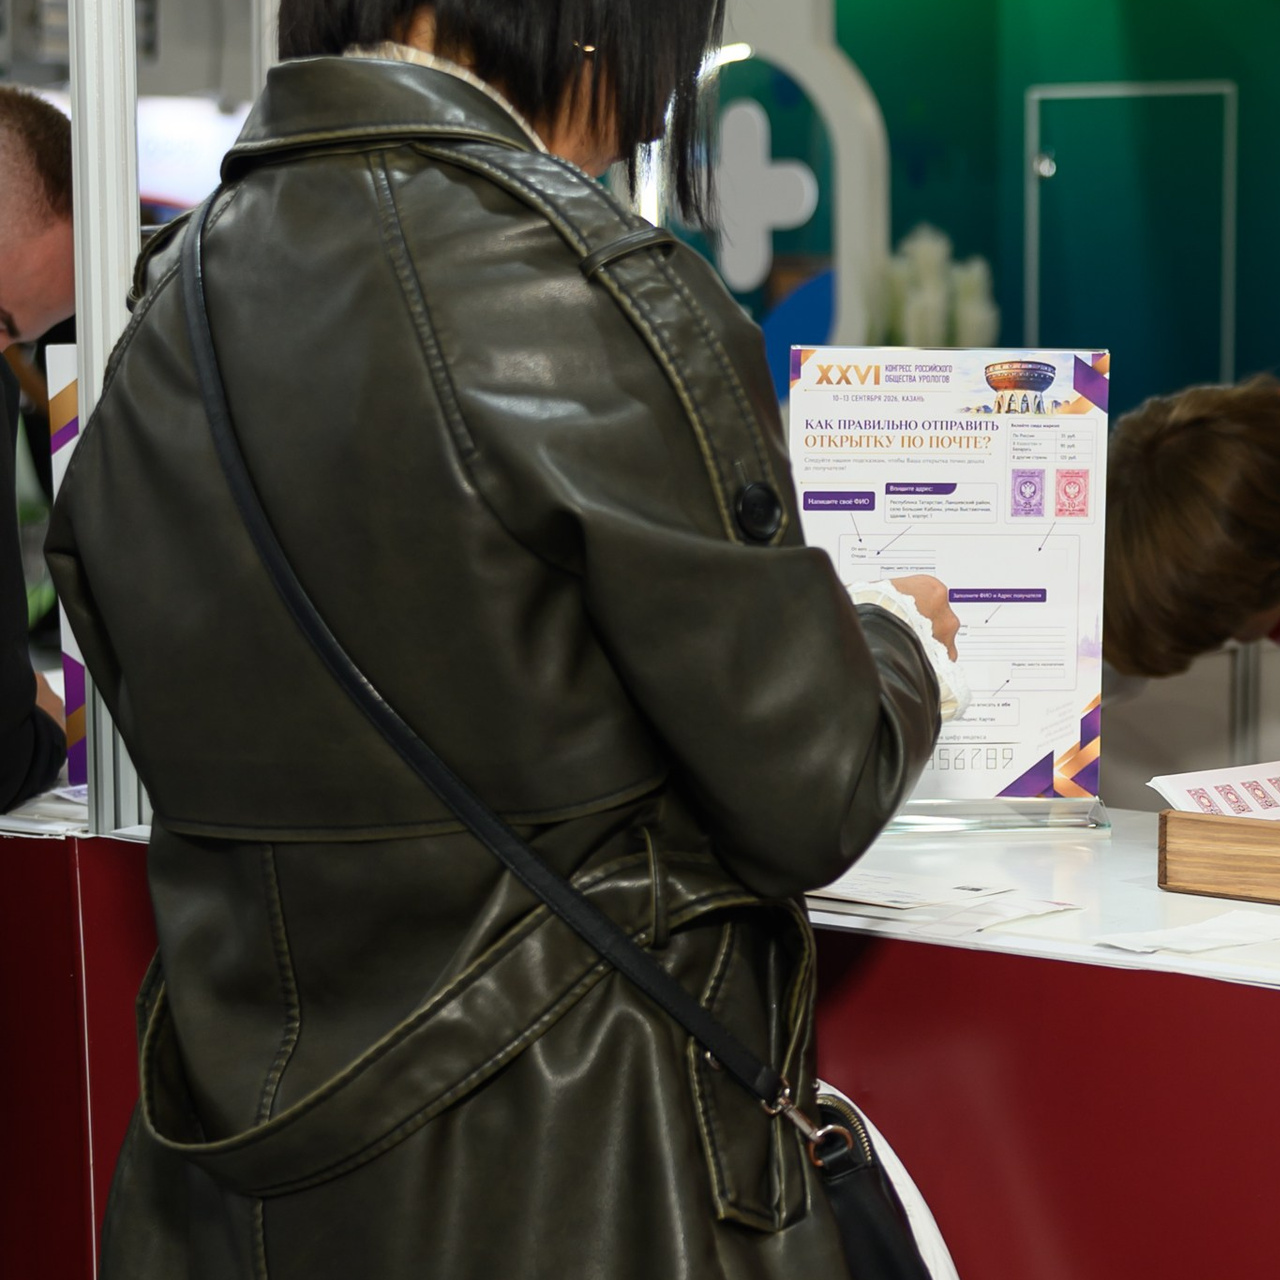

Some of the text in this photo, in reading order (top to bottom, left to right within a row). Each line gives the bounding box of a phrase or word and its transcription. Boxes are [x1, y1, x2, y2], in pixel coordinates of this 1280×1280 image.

[885, 363, 953, 373] КОНГРЕСС РОССИЙСКОГО
[815, 364, 880, 385] XXVI
[885, 375, 950, 384] ОБЩЕСТВА УРОЛОГОВ
[805, 419, 999, 431] КАК ПРАВИЛЬНО ОТПРАВИТЬ
[804, 434, 992, 449] ОТКРЫТКУ ПО ПОЧТЕ?
[853, 498, 870, 506] ФИО
